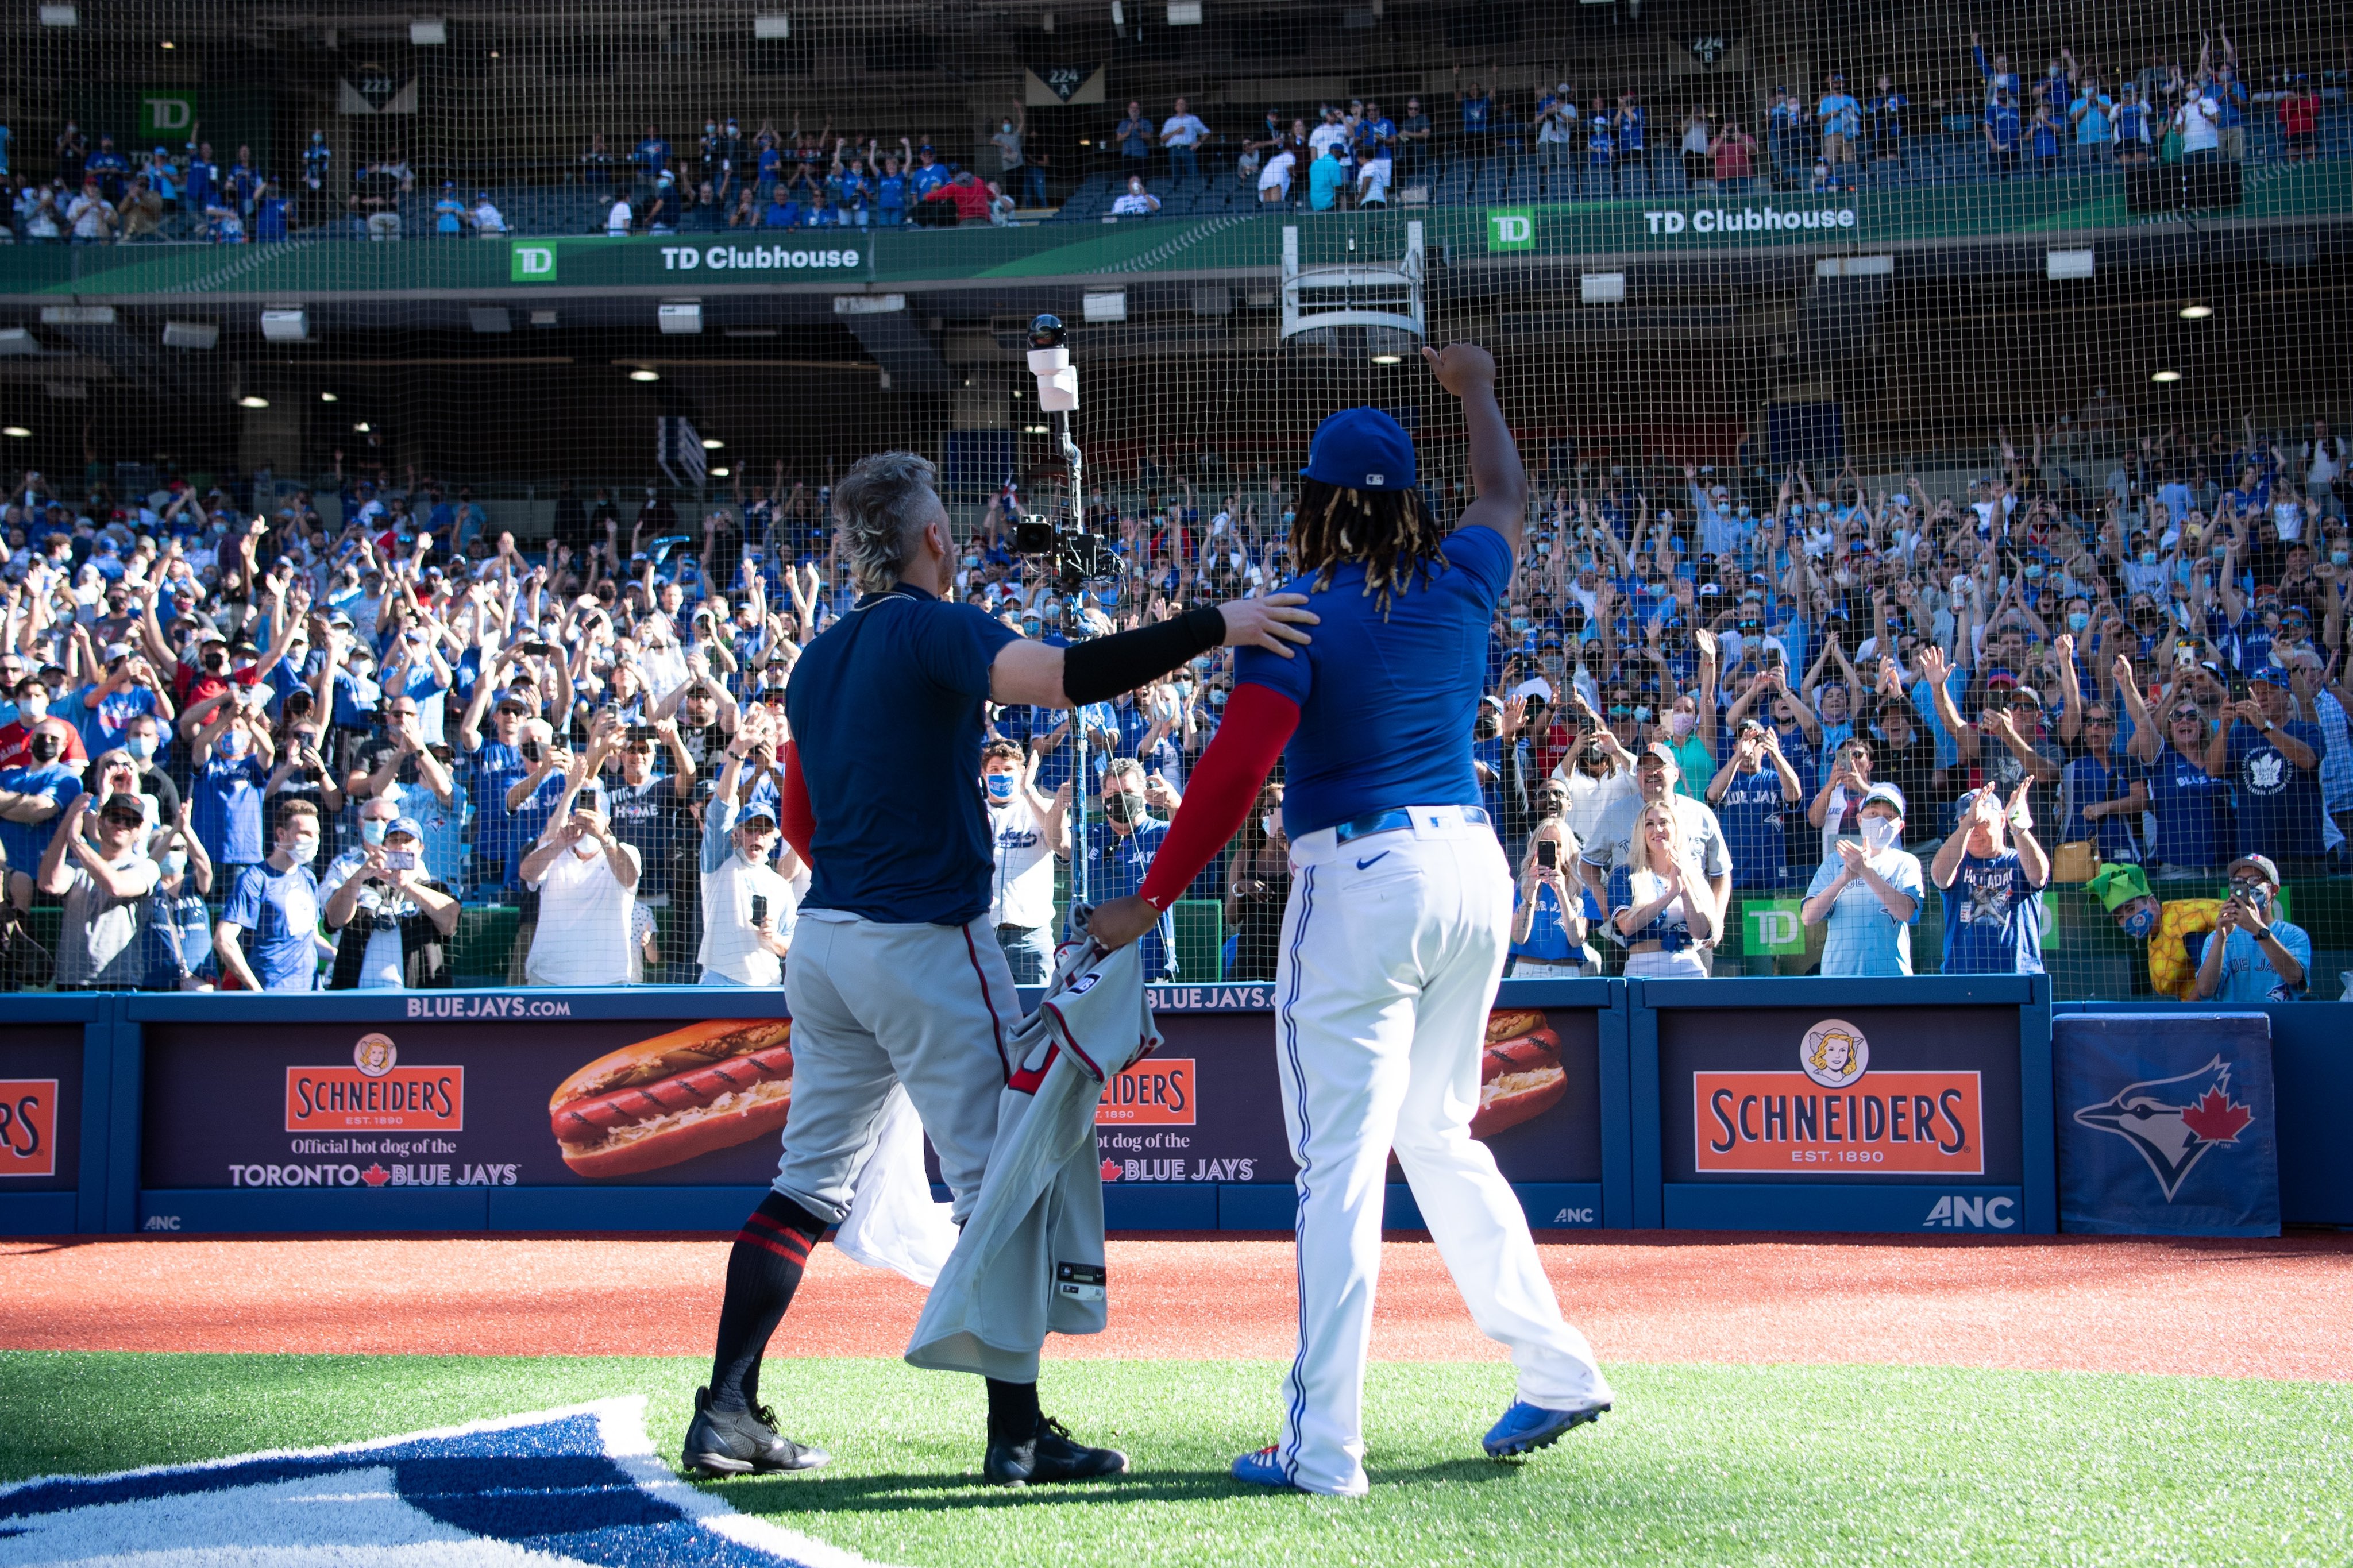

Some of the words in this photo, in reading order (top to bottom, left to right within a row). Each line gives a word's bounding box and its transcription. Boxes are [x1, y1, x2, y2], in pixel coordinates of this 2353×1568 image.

[1049, 69, 1078, 83] 224
[1060, 84, 1069, 95] A
[145, 99, 190, 129] TD
[1492, 217, 1530, 242] TD
[1645, 211, 1685, 234] TD
[1693, 207, 1854, 233] Clubhouse
[516, 248, 553, 273] TD
[661, 247, 700, 270] TD
[706, 245, 859, 269] Clubhouse
[1749, 910, 1797, 944] TD
[296, 1077, 452, 1121] SCHNEIDERS
[346, 1117, 372, 1125] EST.
[375, 1117, 403, 1125] 1890
[1105, 1110, 1134, 1118] 1890
[1710, 1088, 1965, 1156] SCHNEIDERS
[291, 1138, 348, 1154] Official
[352, 1138, 377, 1153] hot
[380, 1138, 410, 1158] dog
[412, 1138, 429, 1154] of
[431, 1138, 457, 1153] the
[1113, 1133, 1142, 1152] dog
[1145, 1133, 1163, 1148] of
[1166, 1133, 1190, 1148] the
[1792, 1150, 1834, 1162] EST.
[1837, 1150, 1884, 1163] 1890
[228, 1164, 360, 1186] TORONTO
[391, 1163, 452, 1186] BLUE
[456, 1163, 518, 1186] JAYS
[1124, 1158, 1185, 1181] BLUE
[1191, 1158, 1254, 1181] JAYS
[143, 1215, 181, 1231] ANC
[1553, 1207, 1594, 1223] ANC
[1922, 1195, 2015, 1229] ANC
